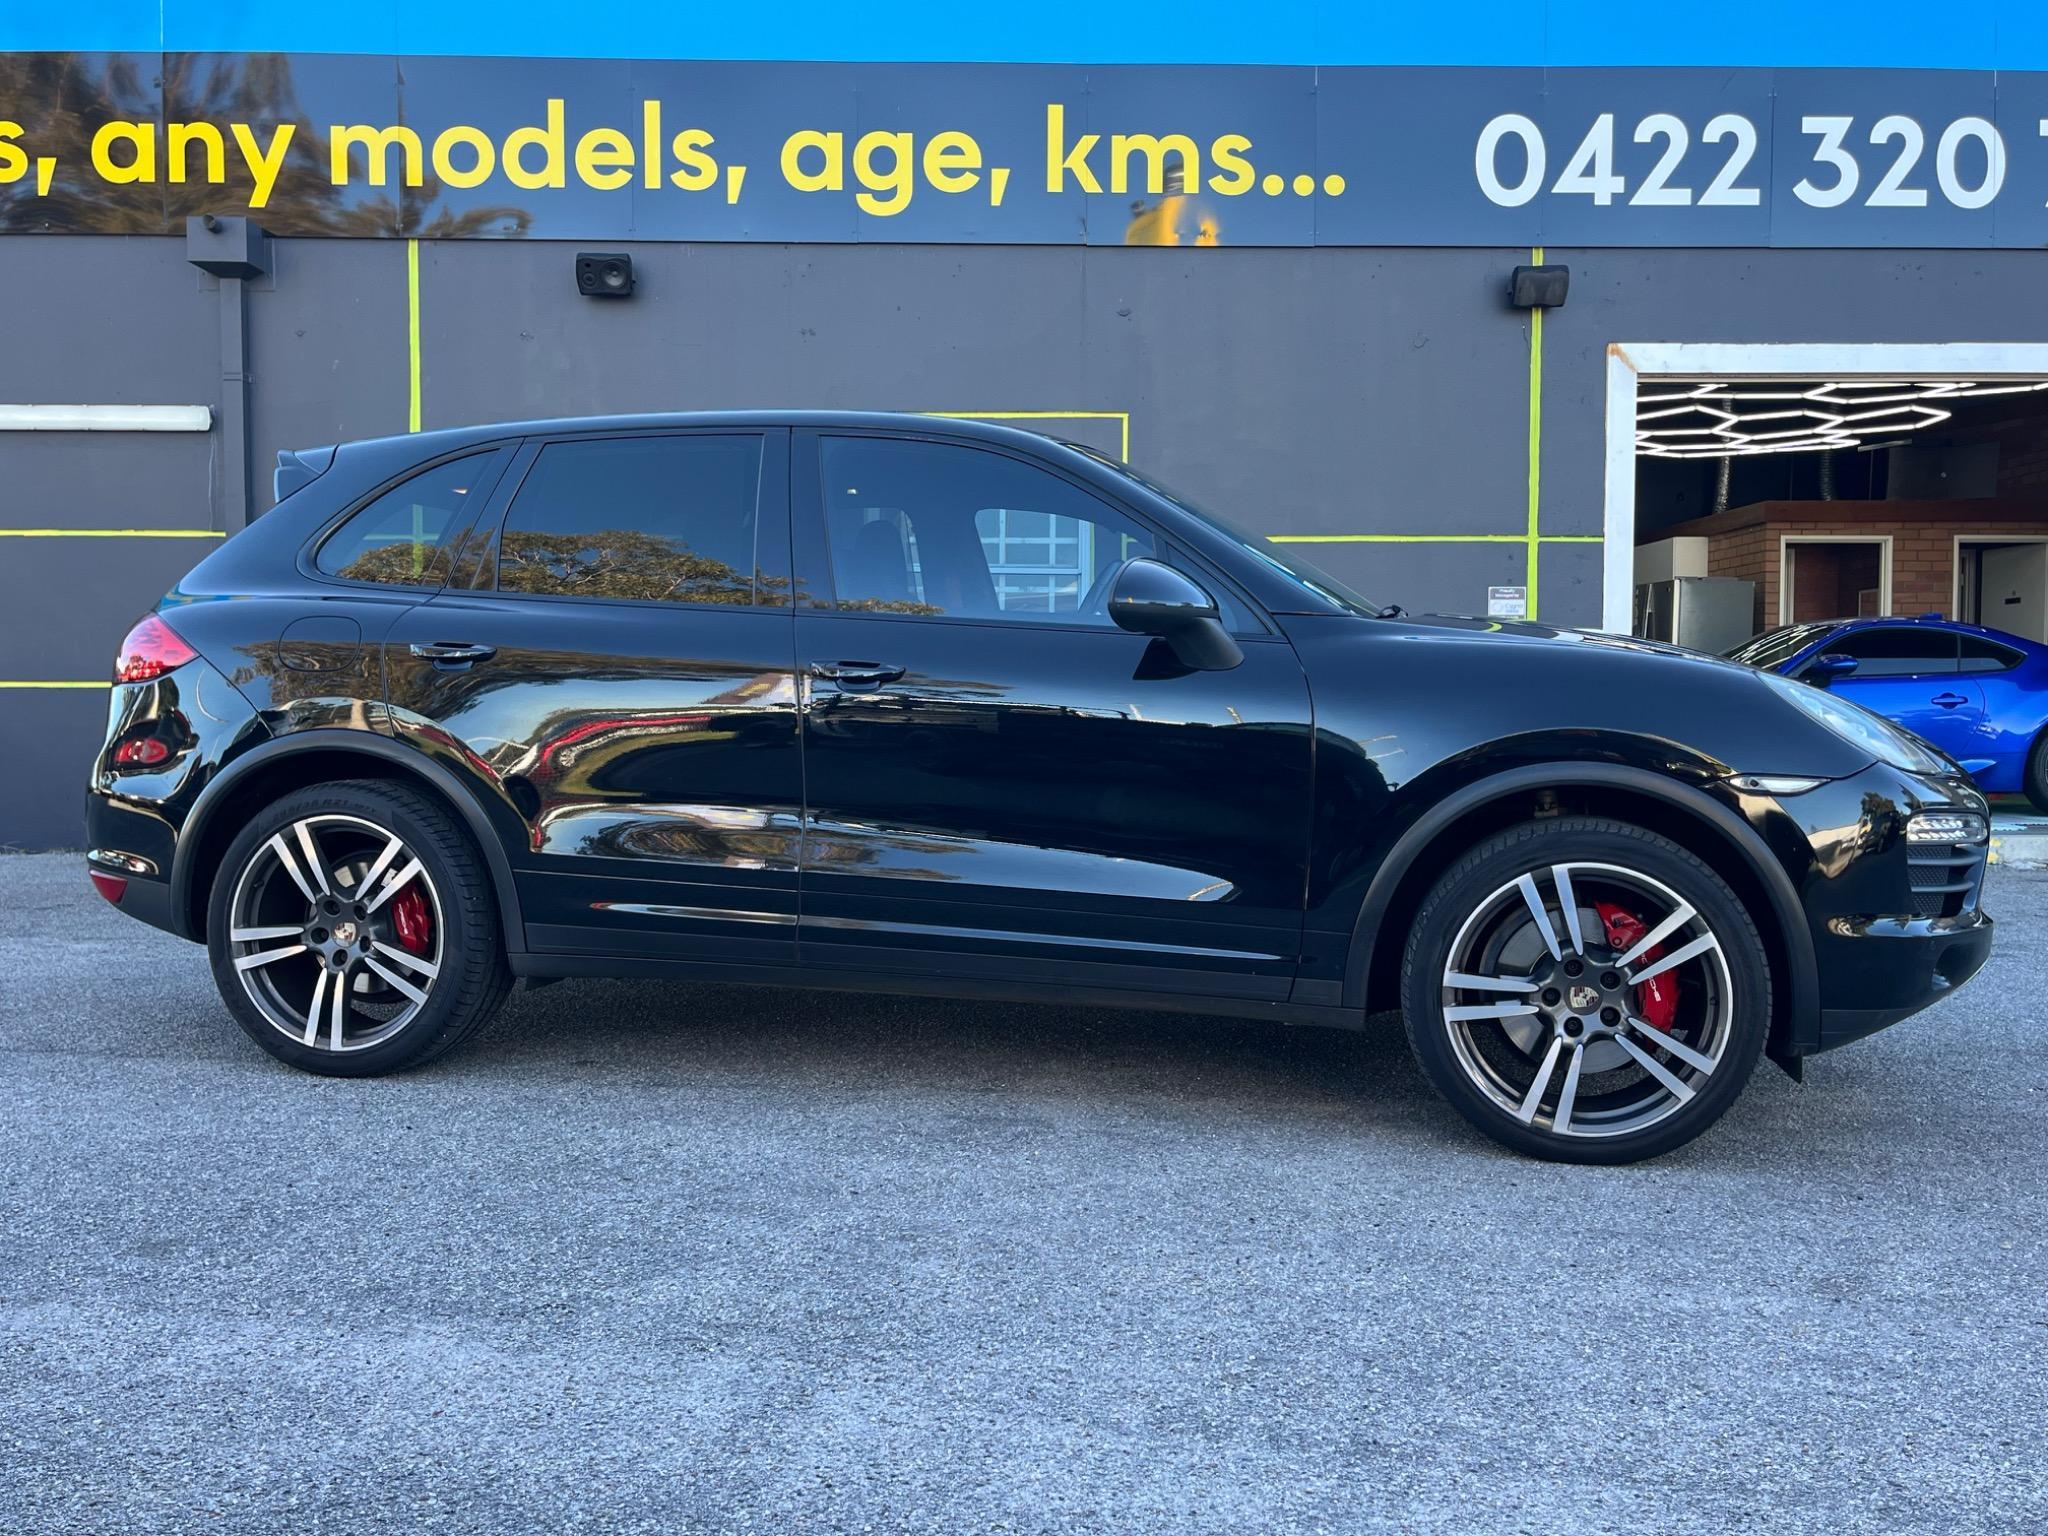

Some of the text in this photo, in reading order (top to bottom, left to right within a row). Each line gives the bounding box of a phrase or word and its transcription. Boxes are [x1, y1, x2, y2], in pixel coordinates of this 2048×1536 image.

[91, 120, 297, 208] any
[330, 98, 745, 203] models,
[781, 130, 1009, 216] age,
[1048, 104, 1344, 196] kms...
[1475, 112, 1761, 207] 0422
[1792, 115, 2006, 209] 320
